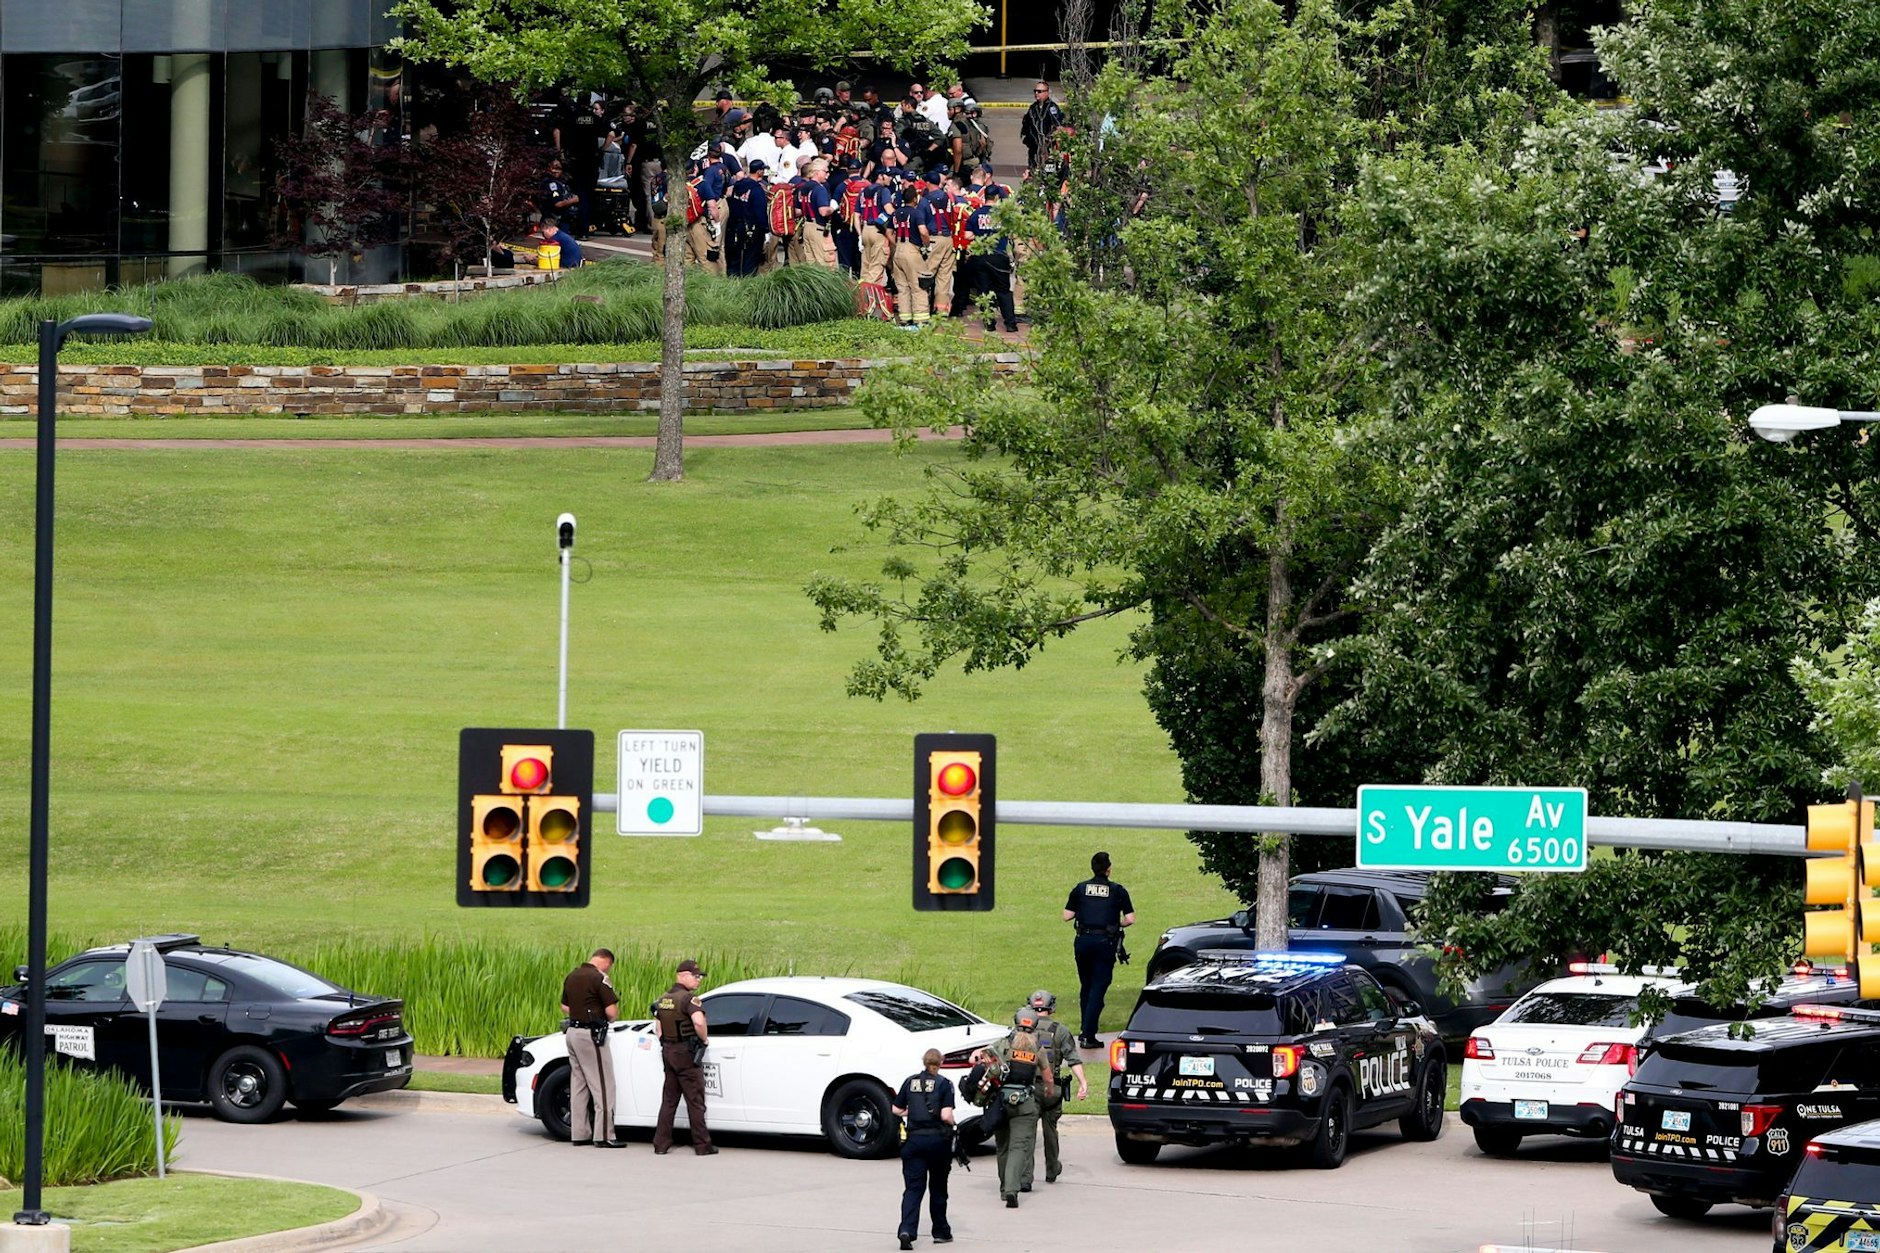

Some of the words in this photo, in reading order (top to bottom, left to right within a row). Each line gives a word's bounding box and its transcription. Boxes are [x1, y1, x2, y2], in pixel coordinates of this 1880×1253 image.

[624, 740, 654, 752] LEFT
[664, 740, 696, 752] TURN
[640, 757, 682, 773] YIELD
[627, 779, 643, 790] ON
[653, 779, 693, 790] GREEN
[1366, 810, 1387, 844] S
[1404, 805, 1494, 850] Yale
[1525, 794, 1565, 829] Av
[1507, 837, 1579, 864] 6500
[1087, 885, 1109, 896] POLICE
[45, 1026, 89, 1034] OKLAHOMA
[59, 1041, 89, 1052] PATROL
[1501, 1057, 1531, 1067] TULSA
[1536, 1058, 1570, 1068] POLICE
[1360, 1050, 1411, 1099] POLICE
[1126, 1074, 1156, 1085] TULSA
[1172, 1078, 1224, 1089] JoinTPD.com
[1234, 1078, 1272, 1089] POLICE
[1818, 1105, 1841, 1113] TULSA
[1623, 1125, 1645, 1137] TULSA
[1654, 1132, 1697, 1144] JoinTPD.com
[1706, 1135, 1740, 1147] POLICE
[1770, 1139, 1786, 1151] 911
